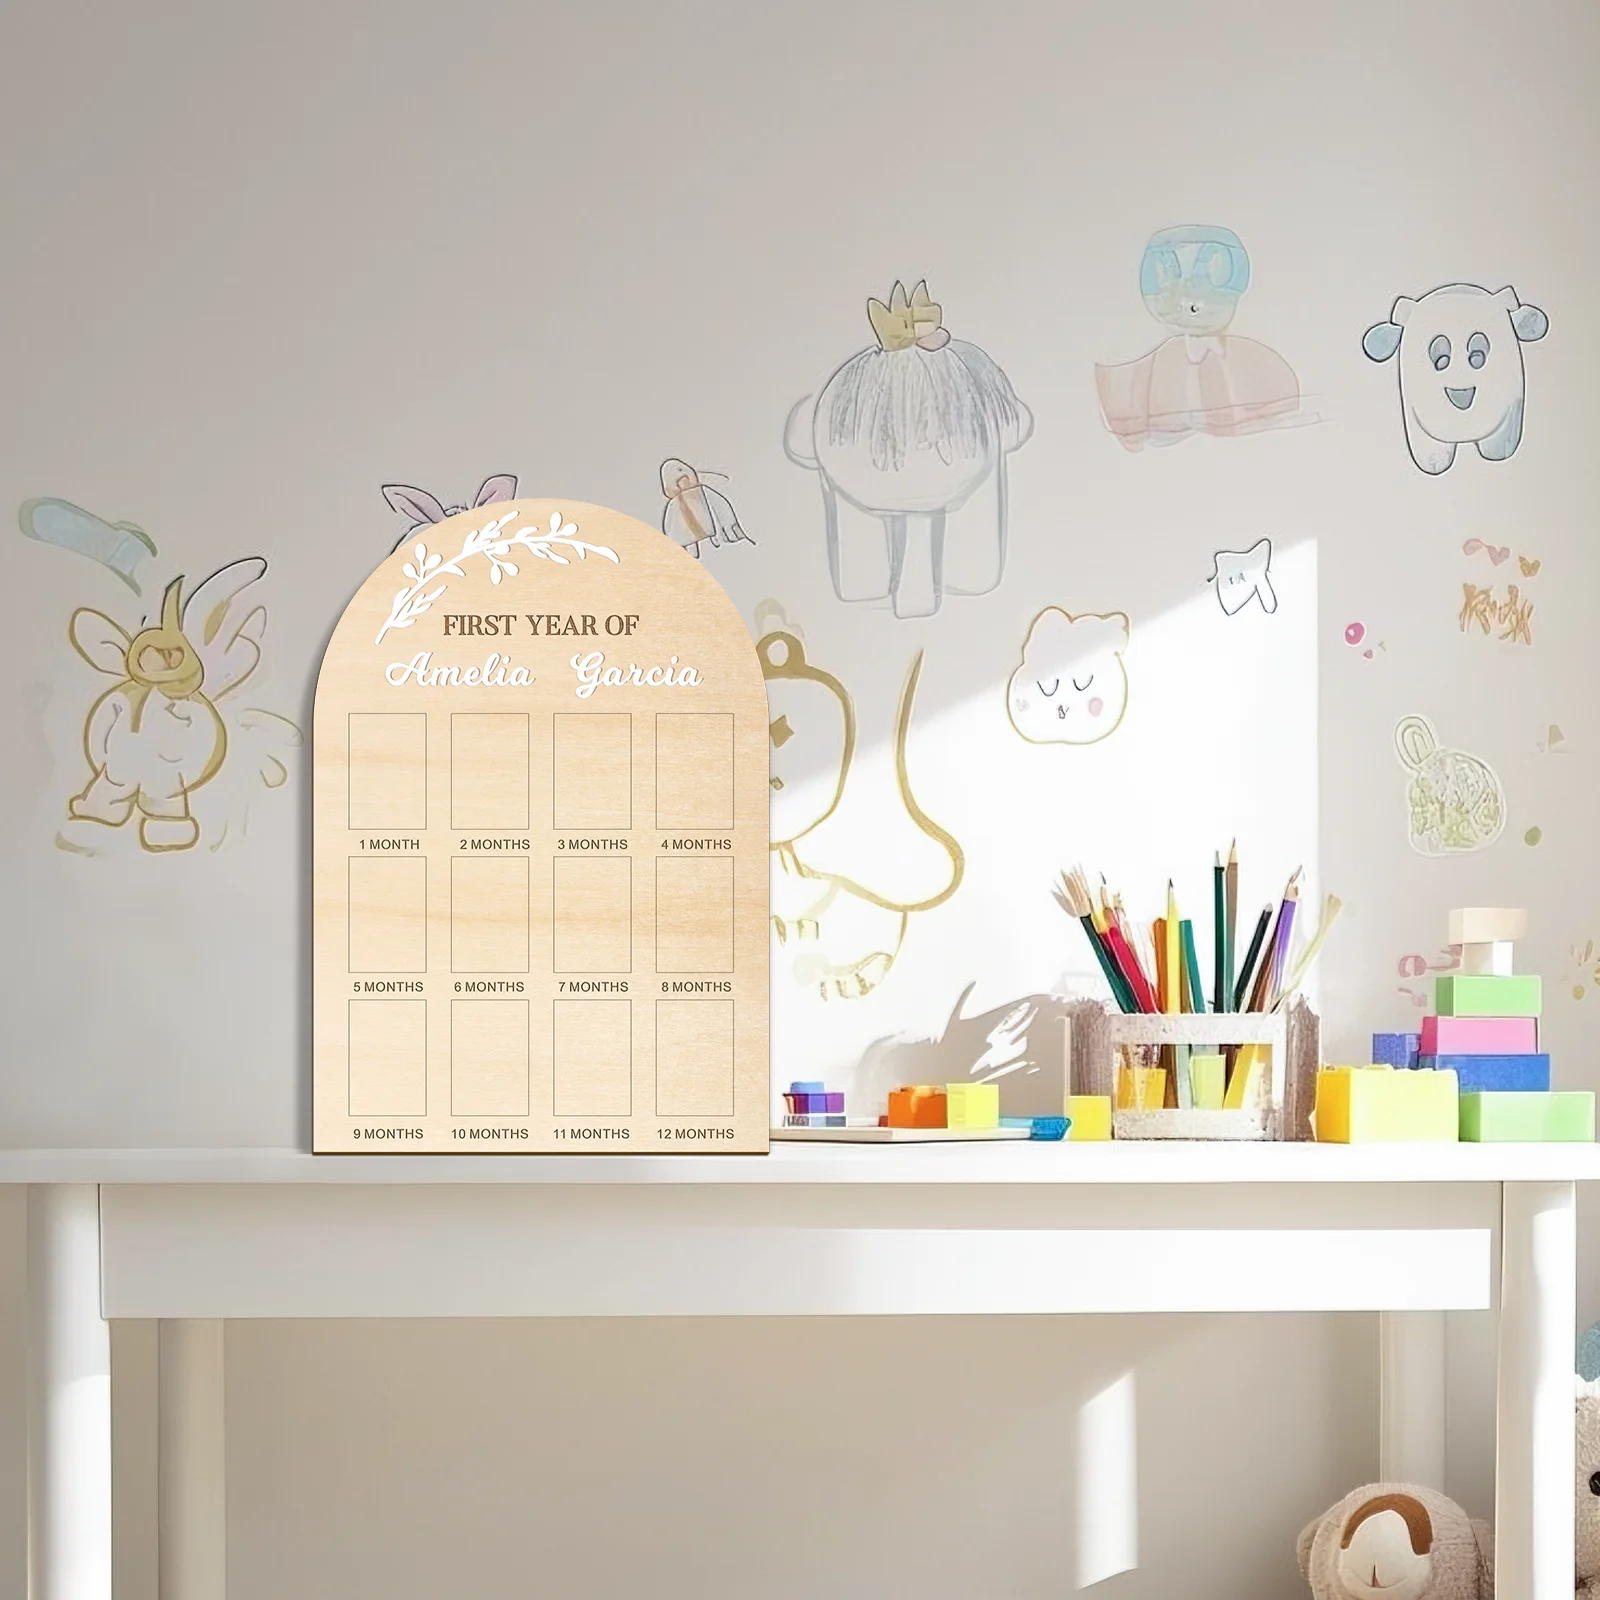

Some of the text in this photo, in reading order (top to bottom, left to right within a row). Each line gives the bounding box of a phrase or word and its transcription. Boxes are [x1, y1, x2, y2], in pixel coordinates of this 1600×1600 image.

[443, 614, 640, 636] FIRST YEAR OF
[385, 651, 703, 699] Amelia Garcia
[358, 838, 420, 850] 1 MONTH
[459, 838, 531, 850] 2 MONTHS
[557, 838, 628, 850] 3 MONTHS
[660, 838, 732, 850] 4 MONTHS
[353, 981, 424, 993] 5 MONTHS
[453, 981, 525, 993] 6 MONTHS
[558, 981, 629, 993] 7 MONTHS
[661, 981, 732, 993] 8 MONTHS
[353, 1128, 424, 1140] 9 MONTHS
[451, 1128, 529, 1140] 10 MONTHS
[553, 1128, 630, 1140] 11 MONTHS
[657, 1128, 735, 1140] 12 MONTHS
